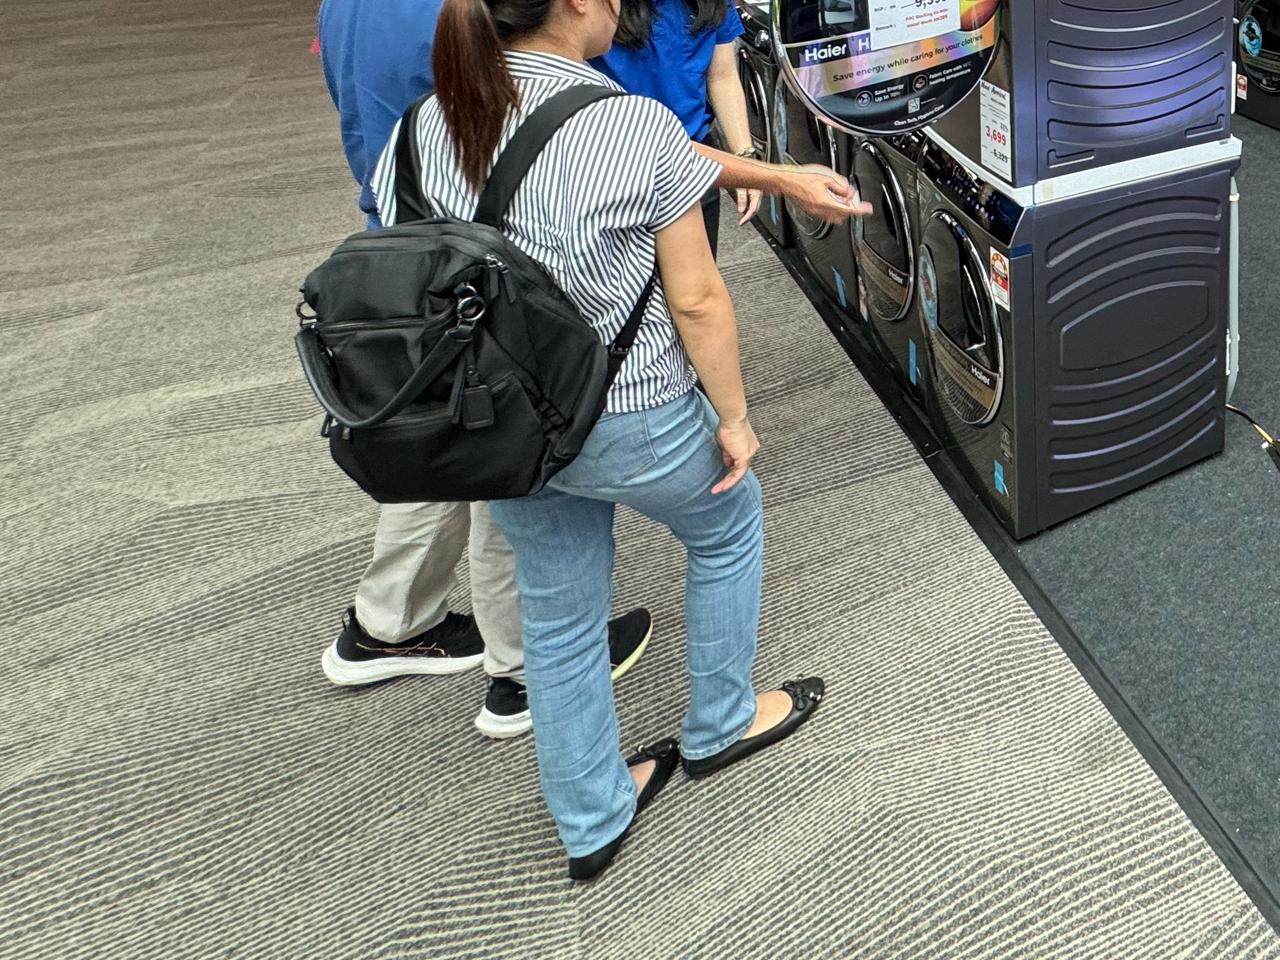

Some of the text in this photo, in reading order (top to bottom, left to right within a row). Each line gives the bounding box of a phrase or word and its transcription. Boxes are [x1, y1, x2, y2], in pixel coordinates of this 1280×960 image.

[804, 42, 847, 63] Haier
[832, 33, 983, 82] Save energy while caring for your clothes
[985, 125, 1007, 147] 3,699
[970, 363, 992, 386] Haier
